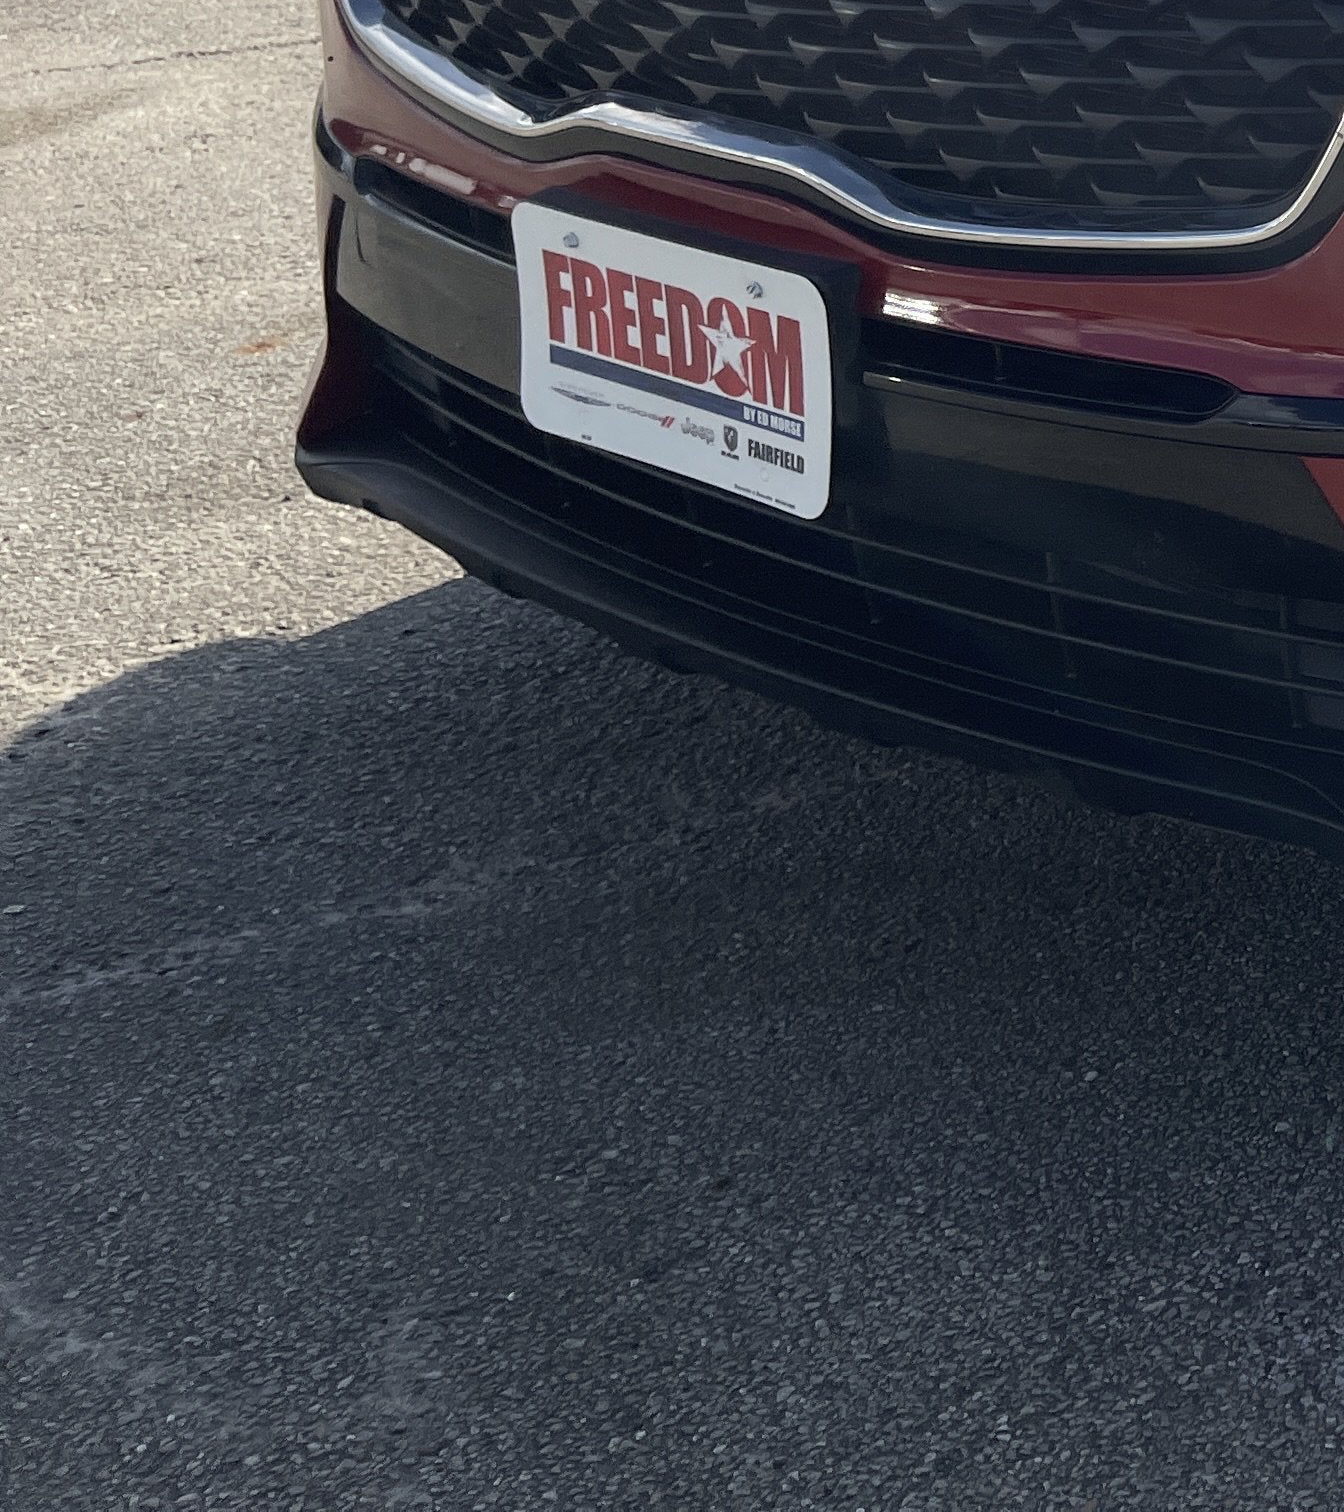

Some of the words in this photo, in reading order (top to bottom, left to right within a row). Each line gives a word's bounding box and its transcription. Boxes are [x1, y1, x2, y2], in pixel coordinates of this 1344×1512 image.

[541, 248, 805, 417] FREEDOM
[743, 405, 757, 422] BY
[757, 410, 769, 426] ED
[747, 438, 805, 475] FAIRFIELD
